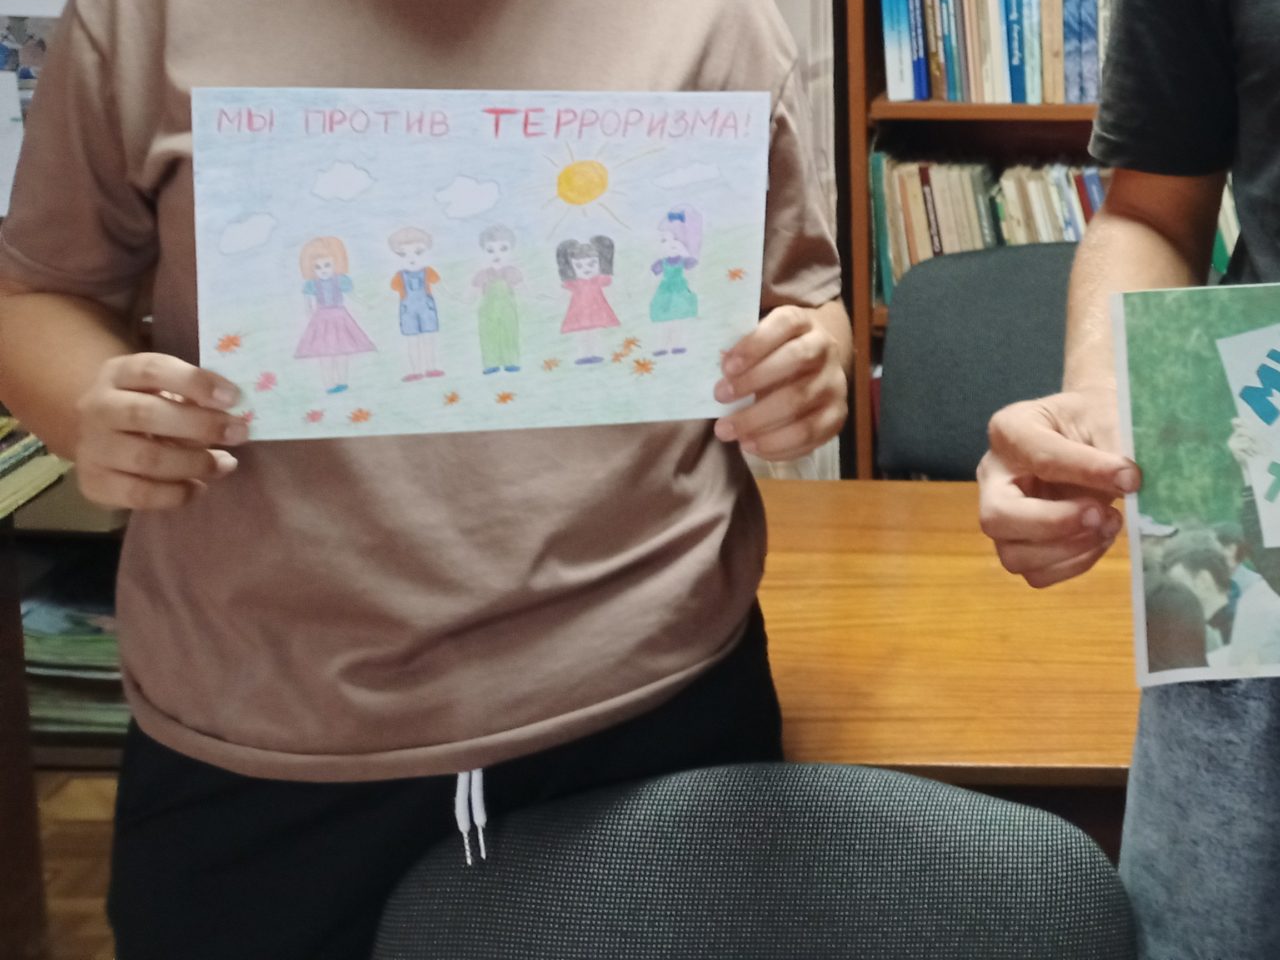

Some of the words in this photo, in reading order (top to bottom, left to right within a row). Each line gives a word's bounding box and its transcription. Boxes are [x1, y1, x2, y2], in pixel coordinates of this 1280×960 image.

[216, 107, 275, 134] МЫ
[304, 108, 449, 135] ПРОТИВ
[481, 106, 753, 139] ТЕРРОРИЗМА!
